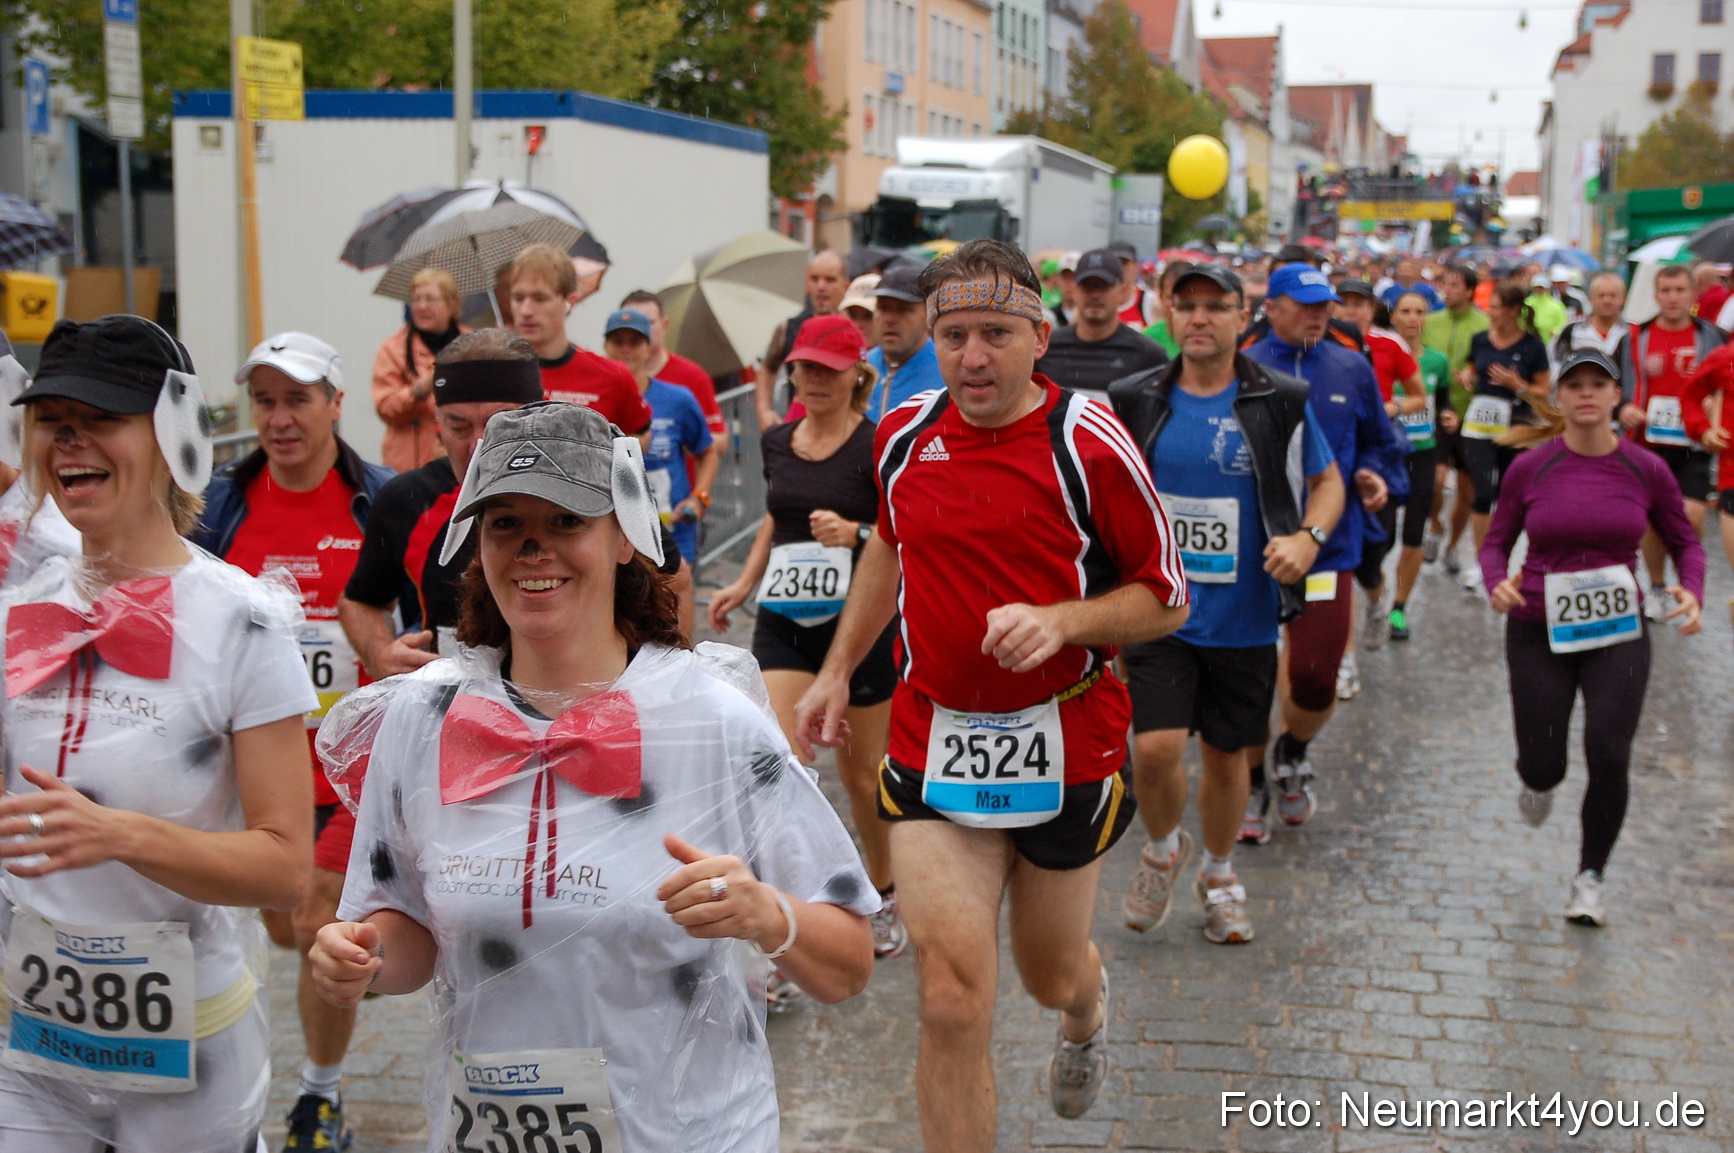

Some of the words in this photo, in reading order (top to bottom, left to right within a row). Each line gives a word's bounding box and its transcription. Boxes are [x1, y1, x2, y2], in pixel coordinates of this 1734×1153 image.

[919, 453, 950, 462] adidas
[331, 538, 362, 550] asics
[767, 567, 839, 598] 2340
[1557, 587, 1628, 622] 2938
[302, 650, 333, 689] 6
[942, 731, 1050, 779] 2524
[975, 791, 1012, 809] Max
[21, 954, 174, 1034] 2386
[36, 1027, 157, 1069] Alexandra
[464, 1063, 541, 1086] BOCK
[450, 1094, 605, 1153] 2385
